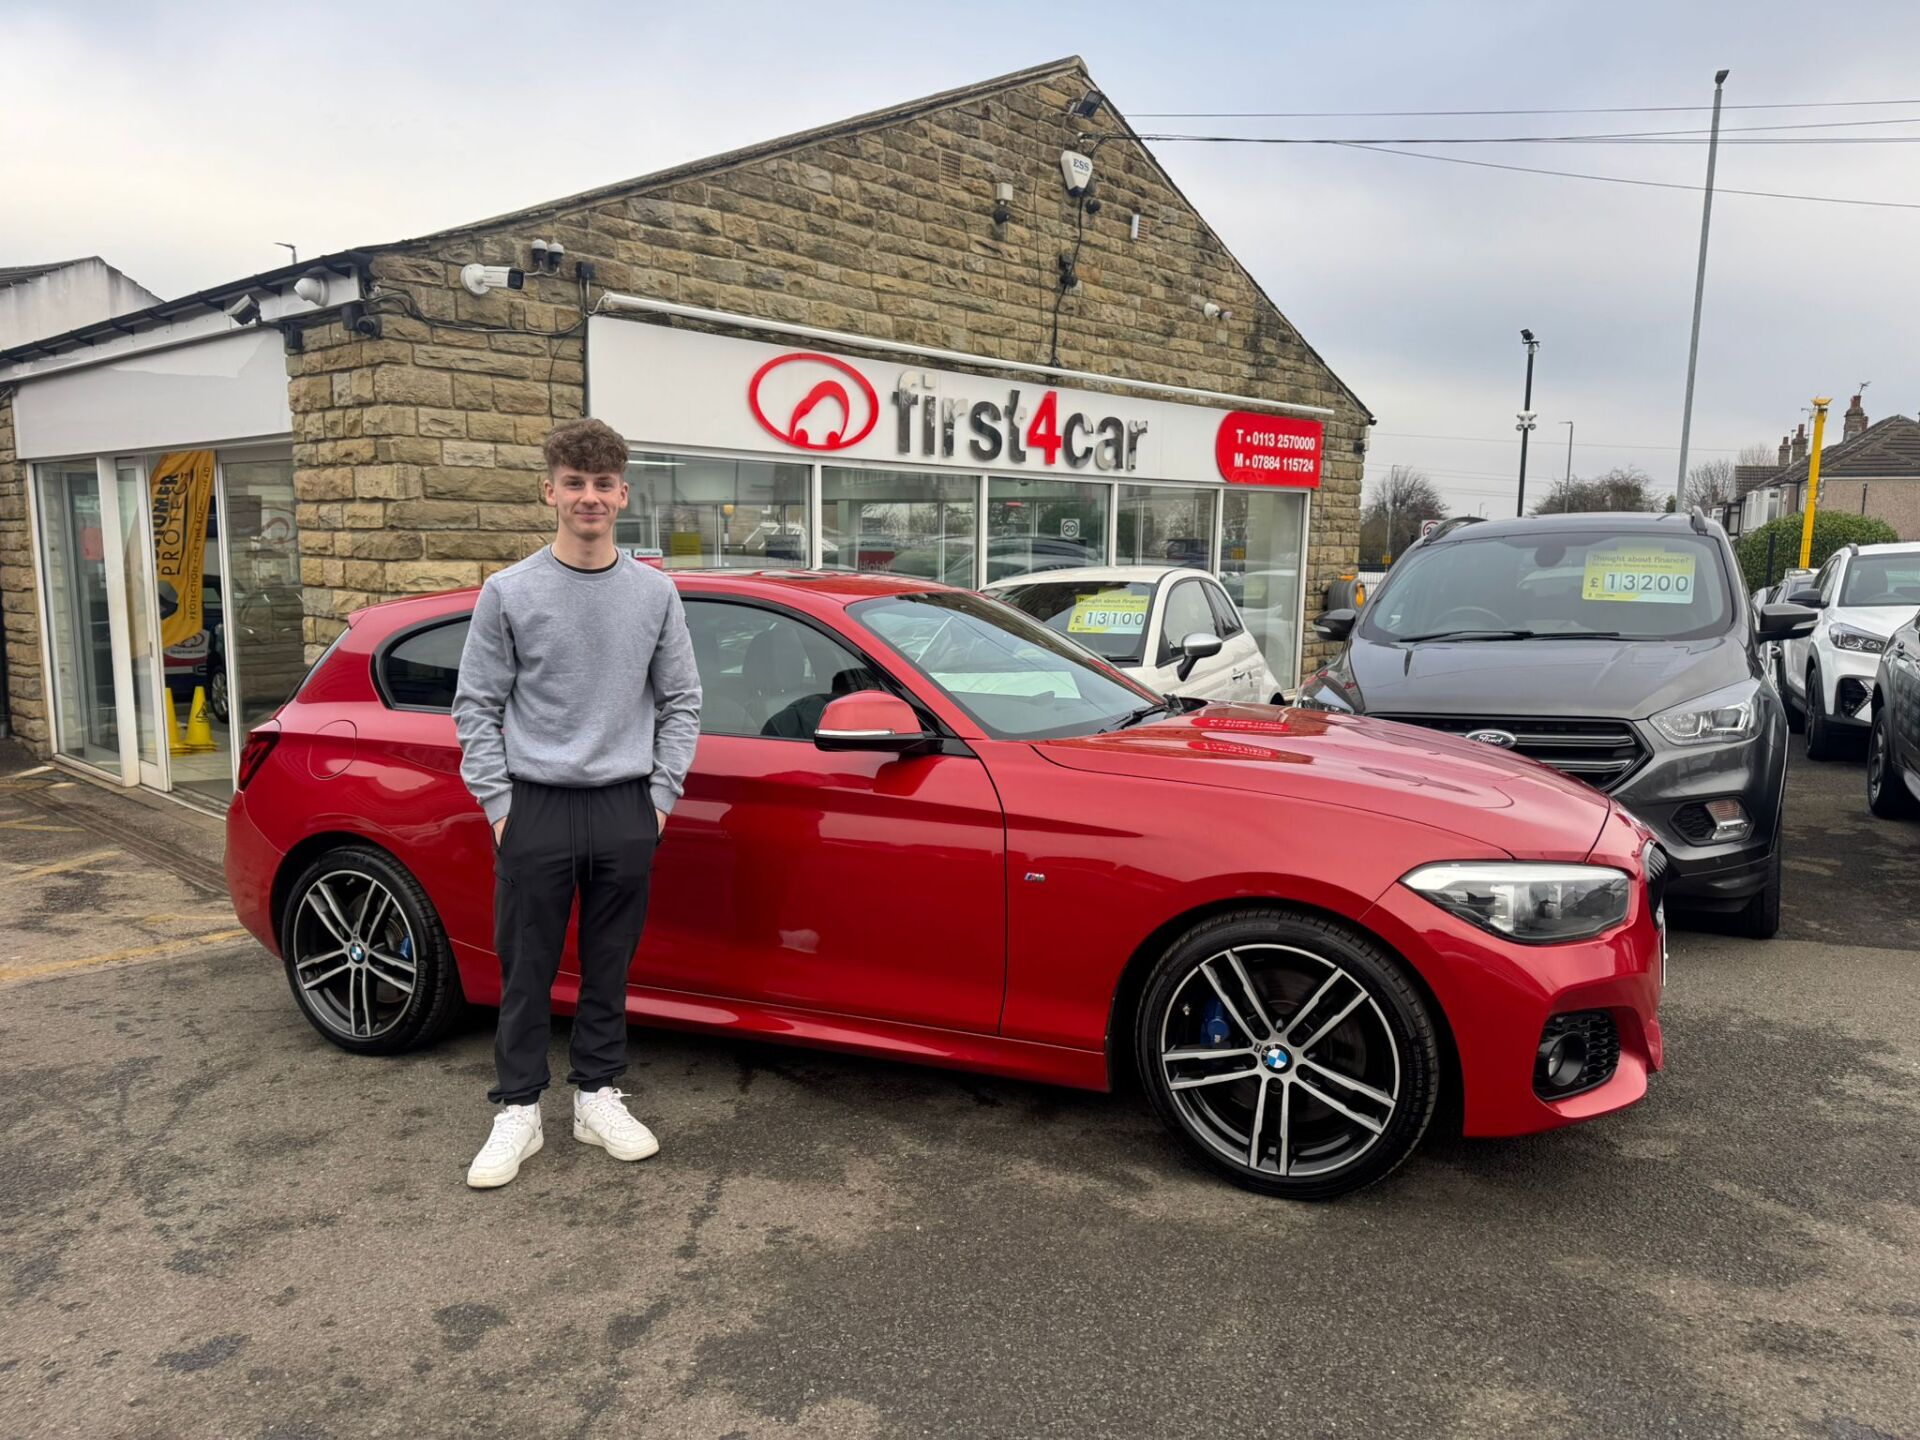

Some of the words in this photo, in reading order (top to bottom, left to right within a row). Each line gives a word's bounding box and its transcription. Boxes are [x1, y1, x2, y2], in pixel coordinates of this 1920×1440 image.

[1073, 158, 1090, 171] ESS
[892, 370, 1148, 472] first4car
[1236, 428, 1244, 444] T
[1252, 431, 1275, 447] 0113
[1277, 434, 1316, 451] 2570000
[1234, 452, 1243, 468] M
[1252, 455, 1281, 471] 07884
[1282, 457, 1315, 473] 115724
[1065, 524, 1076, 533] 20
[1590, 577, 1599, 588] £
[1608, 573, 1689, 592] 13200
[1074, 615, 1082, 624] £
[1087, 611, 1145, 626] 13100
[1477, 733, 1504, 744] Ford
